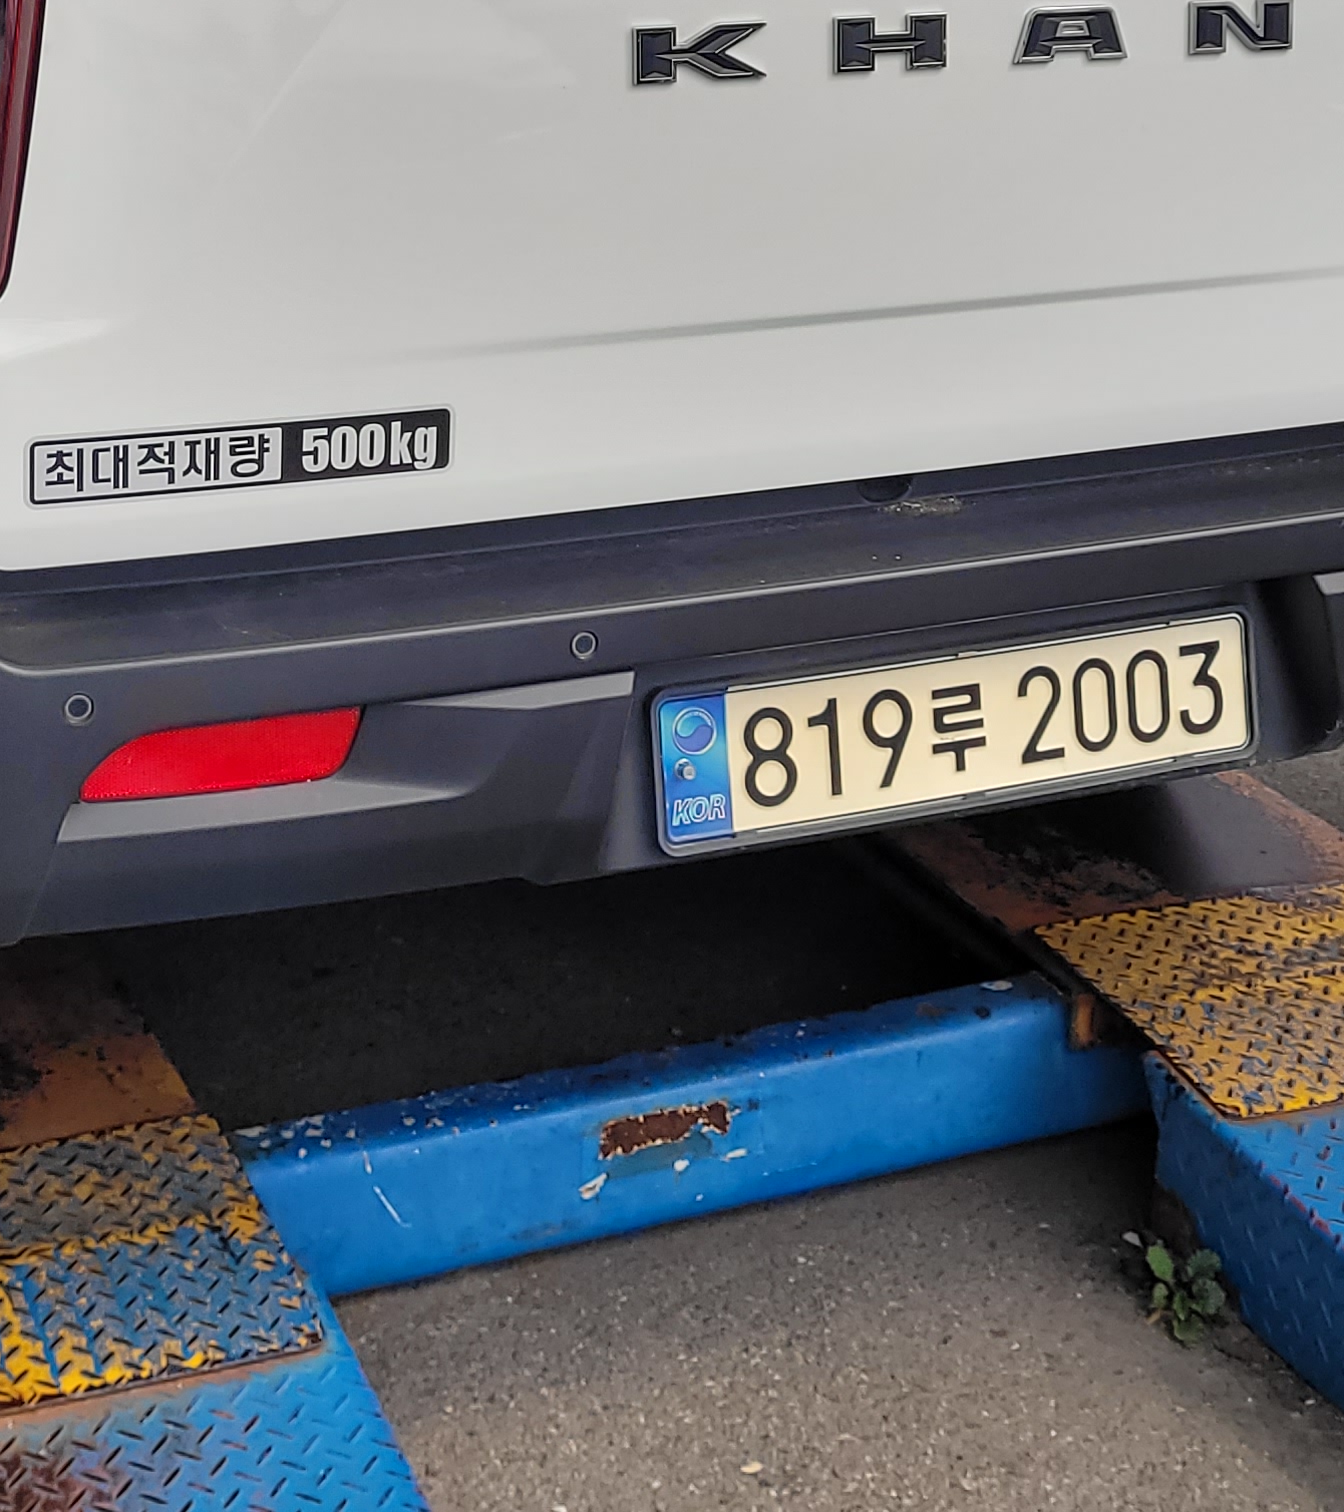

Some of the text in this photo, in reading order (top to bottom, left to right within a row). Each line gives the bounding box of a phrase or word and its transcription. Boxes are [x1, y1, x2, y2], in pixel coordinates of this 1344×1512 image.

[44, 420, 438, 493] 최대적재량 500kg
[743, 639, 1224, 808] 819루 2003
[672, 793, 726, 826] KOR
